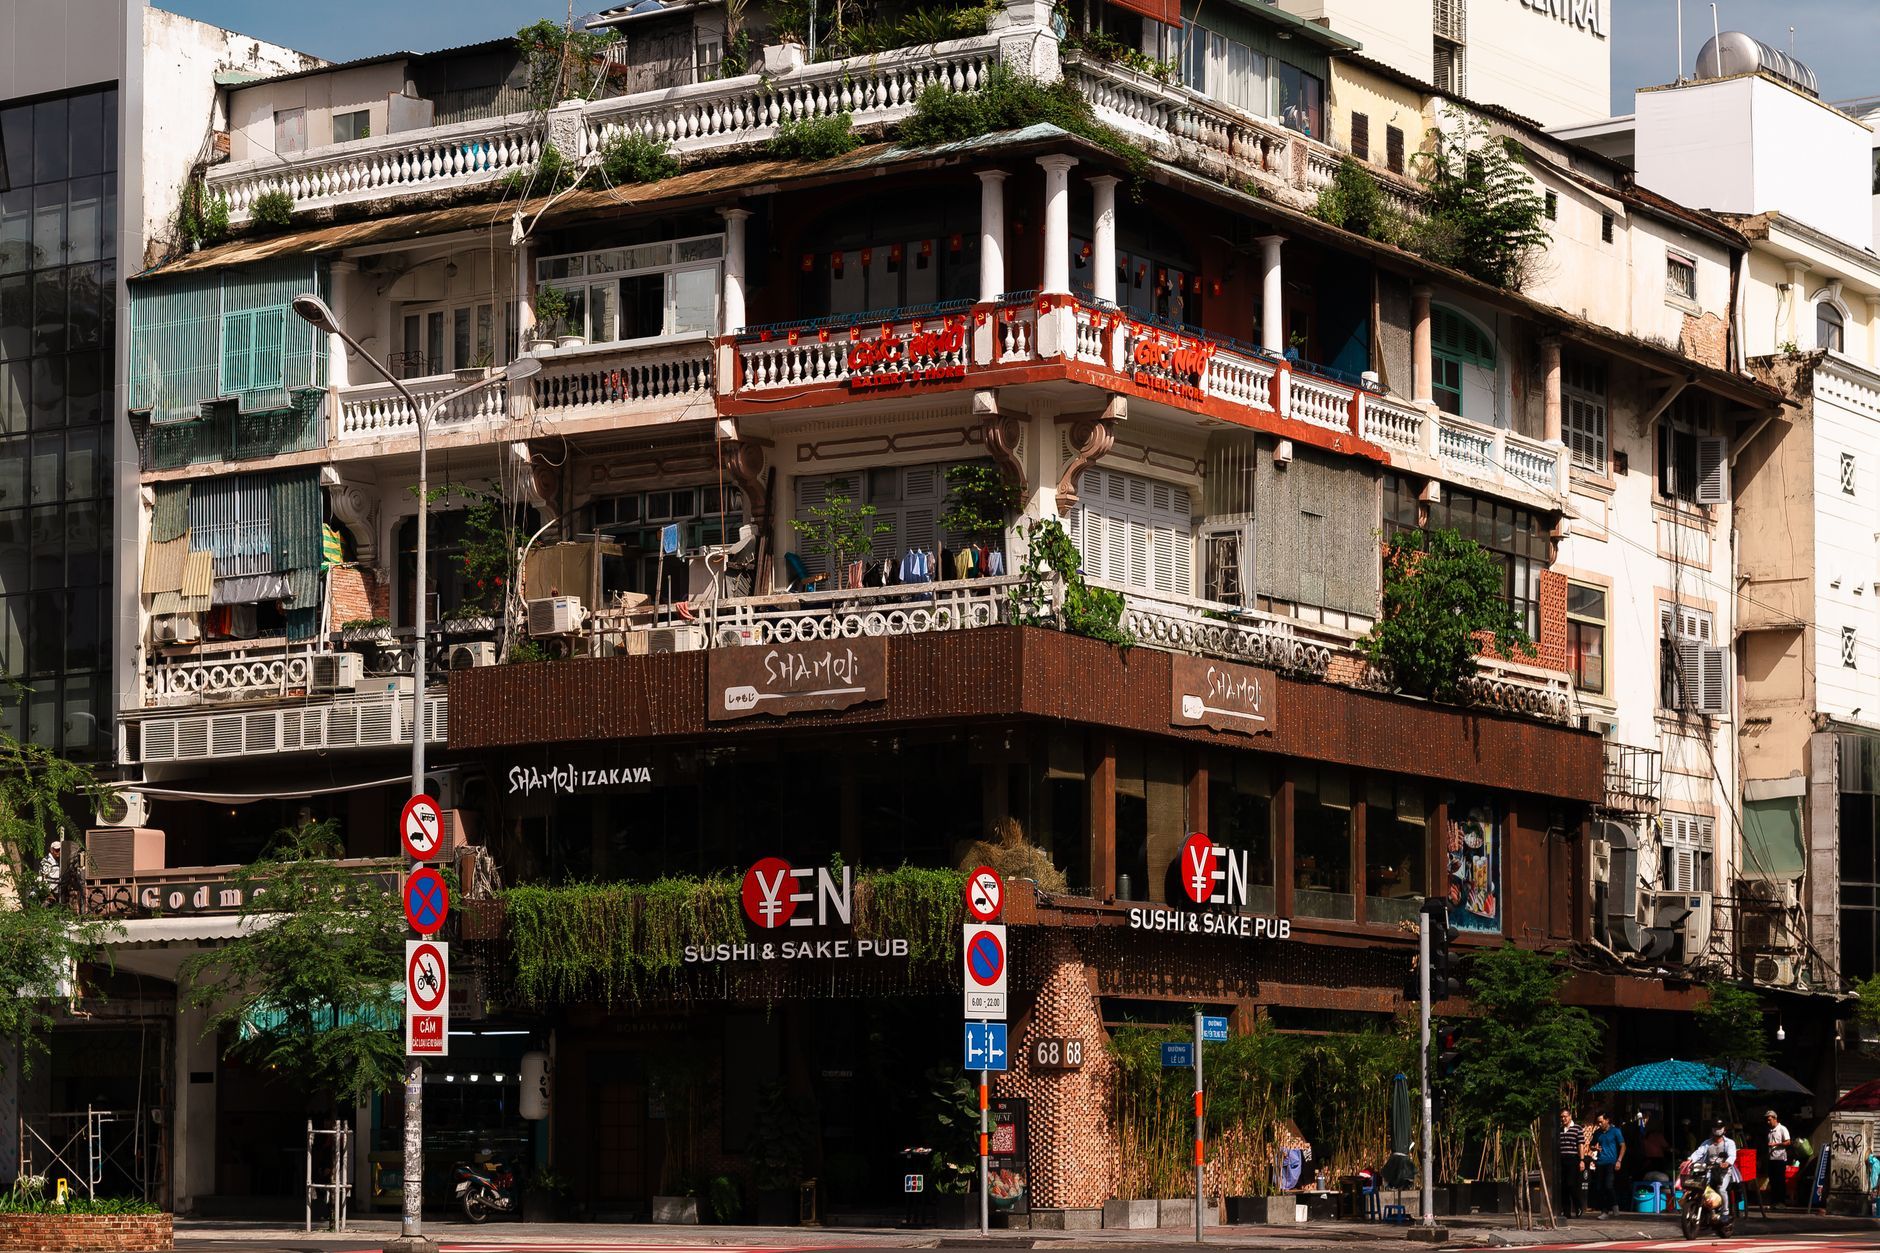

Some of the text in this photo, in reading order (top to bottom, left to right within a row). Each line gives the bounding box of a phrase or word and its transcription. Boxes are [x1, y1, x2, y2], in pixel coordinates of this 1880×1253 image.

[1520, 0, 1607, 38] NTRAL
[925, 365, 965, 380] MORE
[1181, 385, 1205, 401] MORE
[582, 767, 651, 786] IZAKAYA
[1130, 908, 1291, 939] SUSHI & SAKE PUB
[684, 939, 908, 963] SUSHI & SAKE PUB
[420, 1016, 436, 1033] CẤM
[1037, 1042, 1059, 1064] 68
[1067, 1042, 1080, 1064] 68
